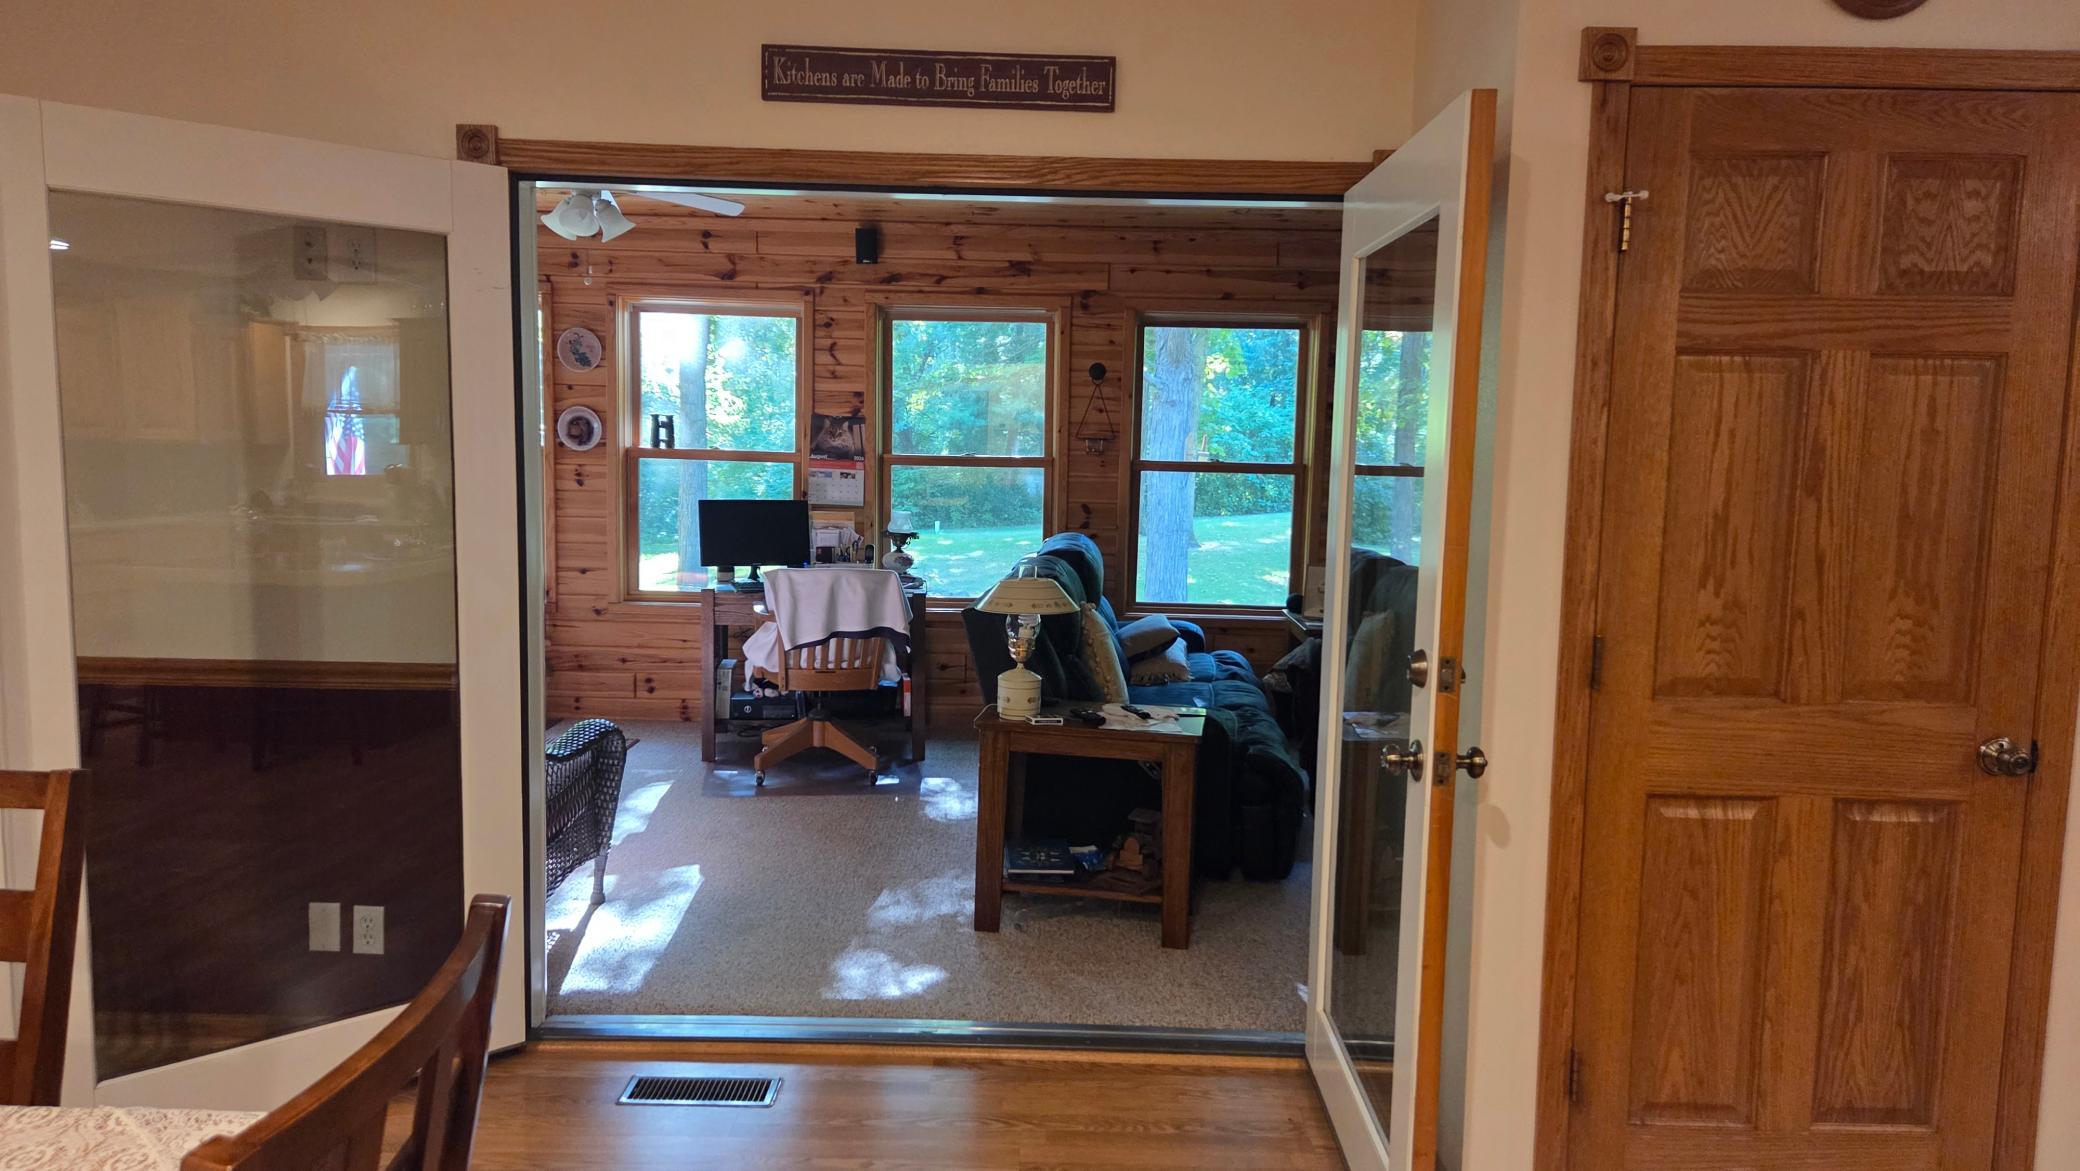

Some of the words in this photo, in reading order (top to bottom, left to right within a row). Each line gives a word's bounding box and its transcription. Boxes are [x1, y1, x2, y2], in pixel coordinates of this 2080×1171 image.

[772, 55, 838, 86] Kitchens
[842, 71, 865, 87] are
[870, 60, 911, 88] Made
[916, 68, 930, 89] to
[934, 62, 975, 97] Bring
[979, 64, 1039, 93] Families
[1043, 65, 1106, 99] Together
